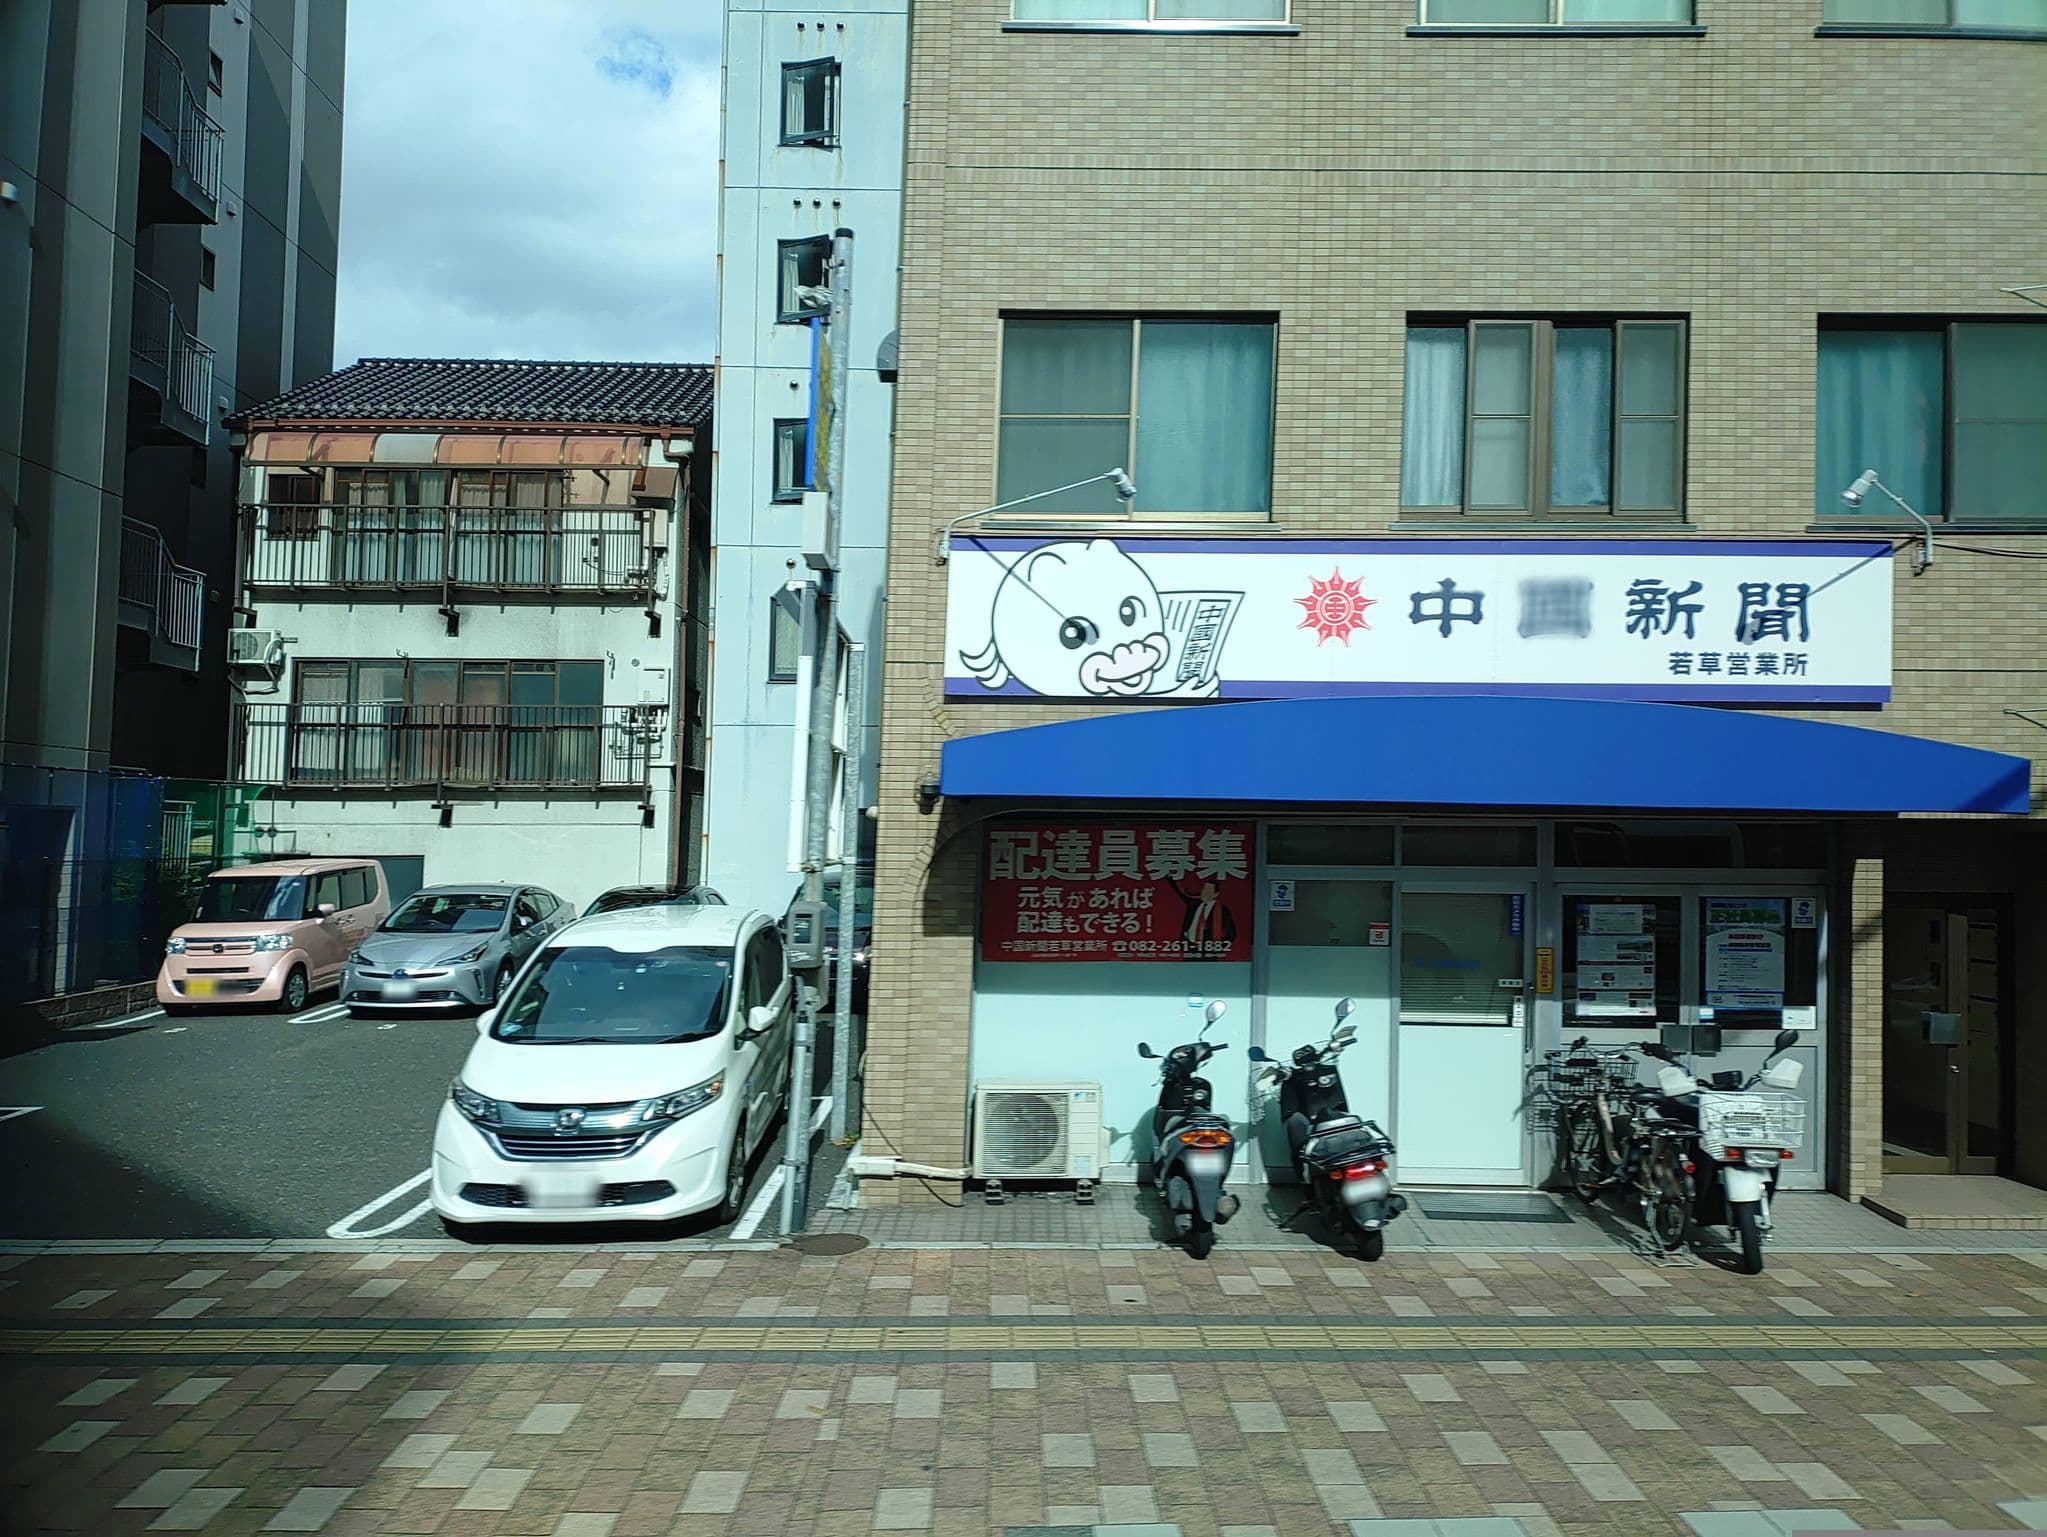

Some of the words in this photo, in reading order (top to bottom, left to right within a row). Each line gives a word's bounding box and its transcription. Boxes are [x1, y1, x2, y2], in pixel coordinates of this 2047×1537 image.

[1409, 577, 1812, 643] 中新聞
[1669, 651, 1809, 676] 若草営業所
[989, 829, 1249, 881] 配達員募集
[1017, 886, 1154, 909] 元気があれば
[1128, 940, 1232, 952] 082-261-1882
